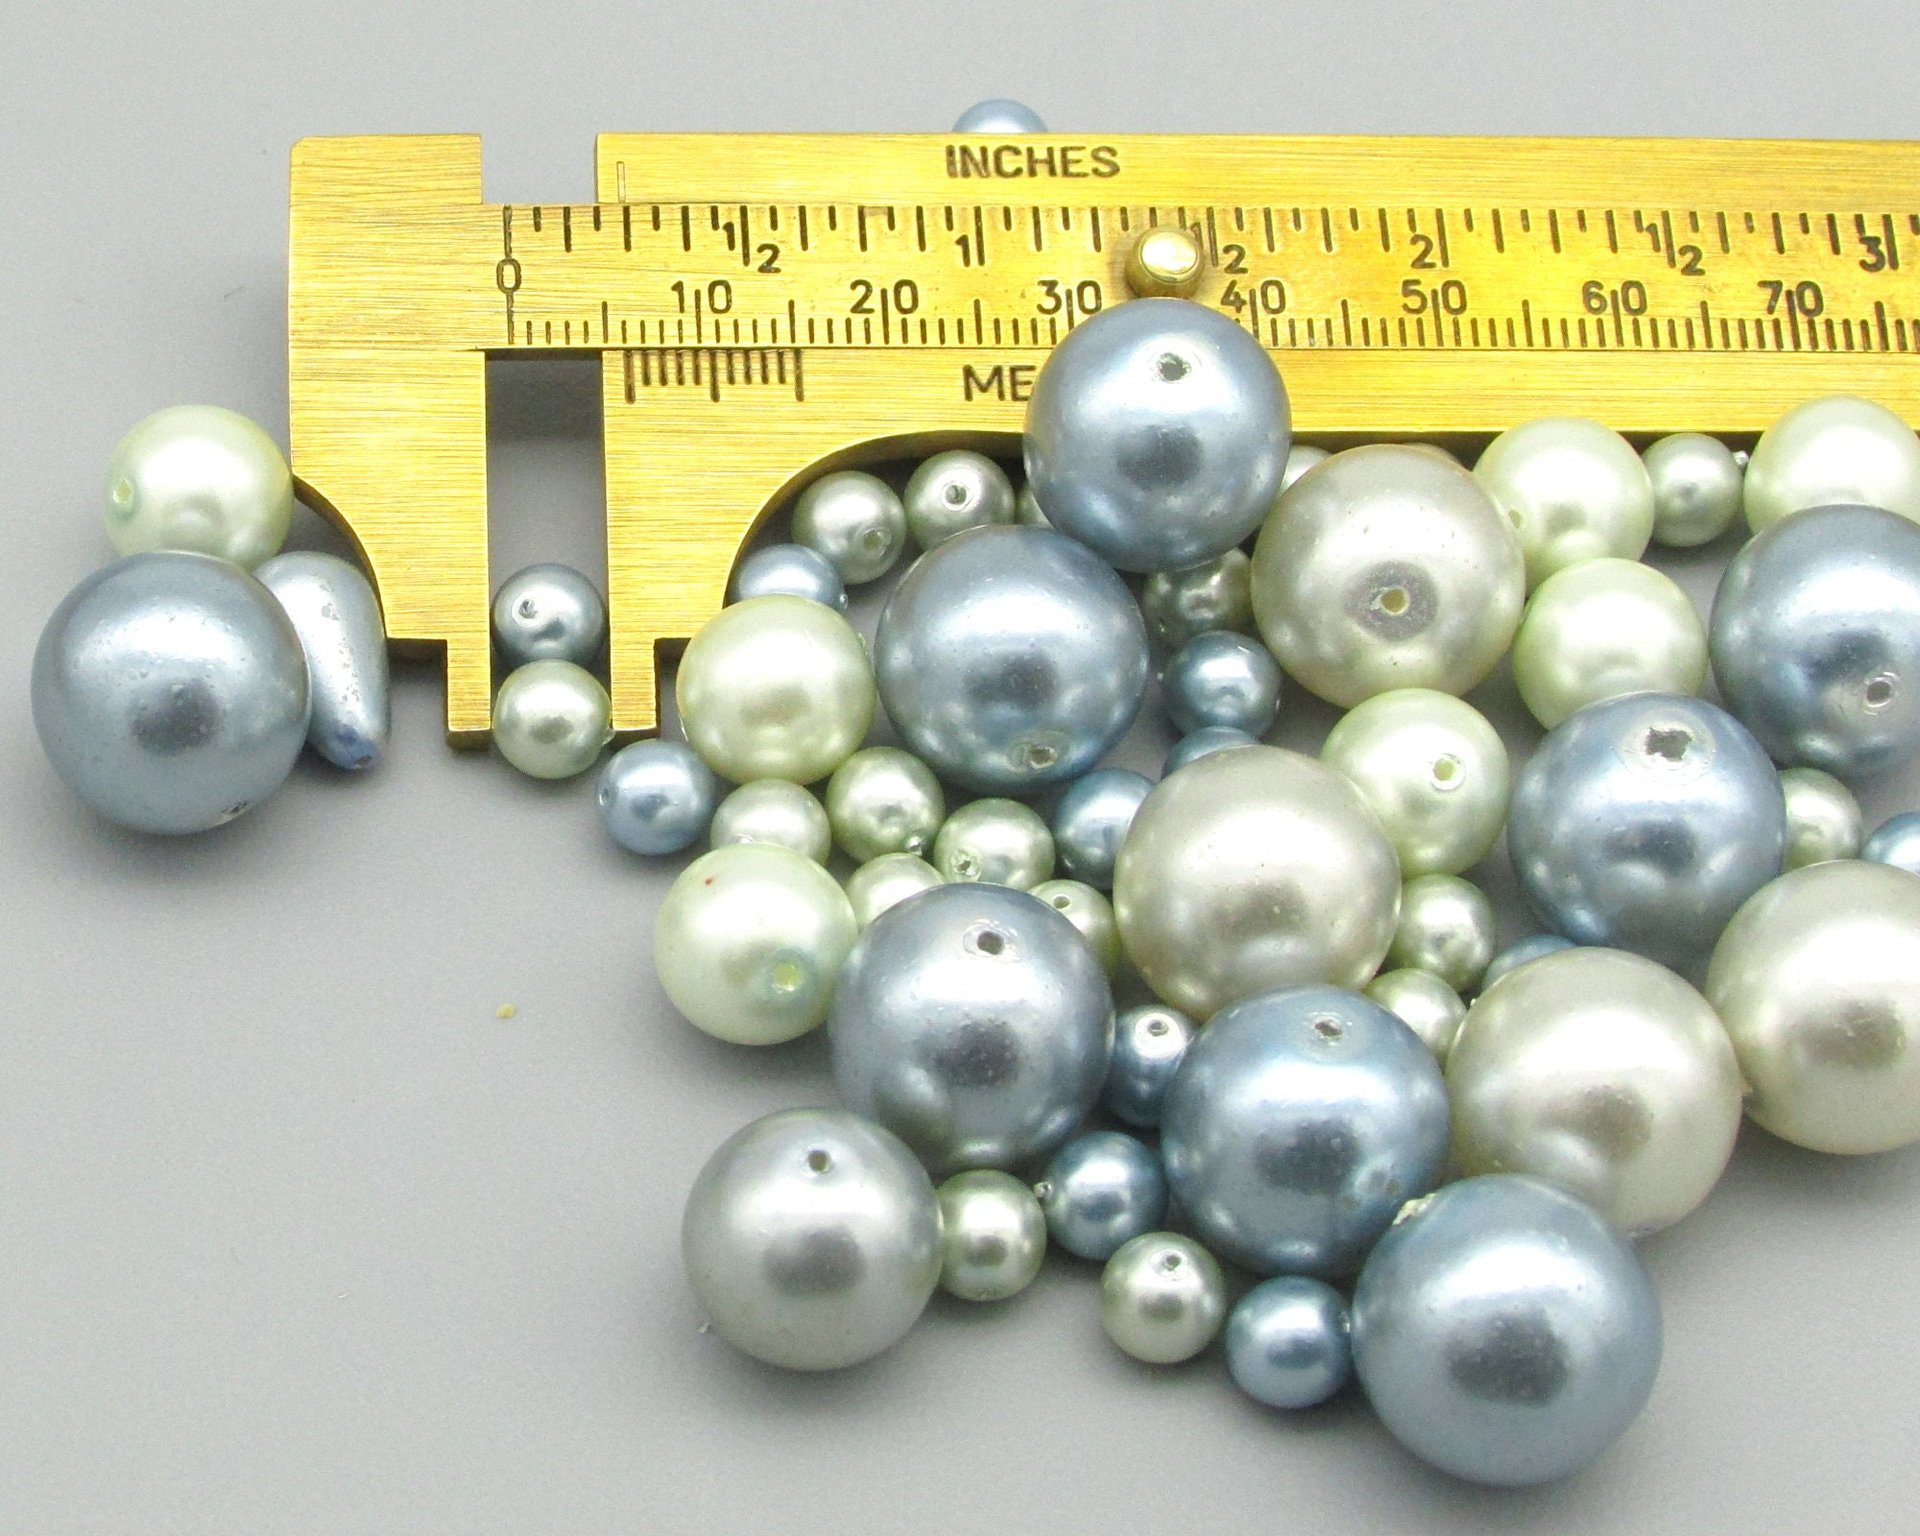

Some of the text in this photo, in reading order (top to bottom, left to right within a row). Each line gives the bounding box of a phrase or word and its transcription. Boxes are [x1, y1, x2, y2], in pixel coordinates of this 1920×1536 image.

[946, 145, 1120, 178] INCHES
[954, 234, 970, 267] 1
[1410, 234, 1436, 270] 2
[1859, 236, 1886, 273] 3
[496, 258, 522, 294] 0
